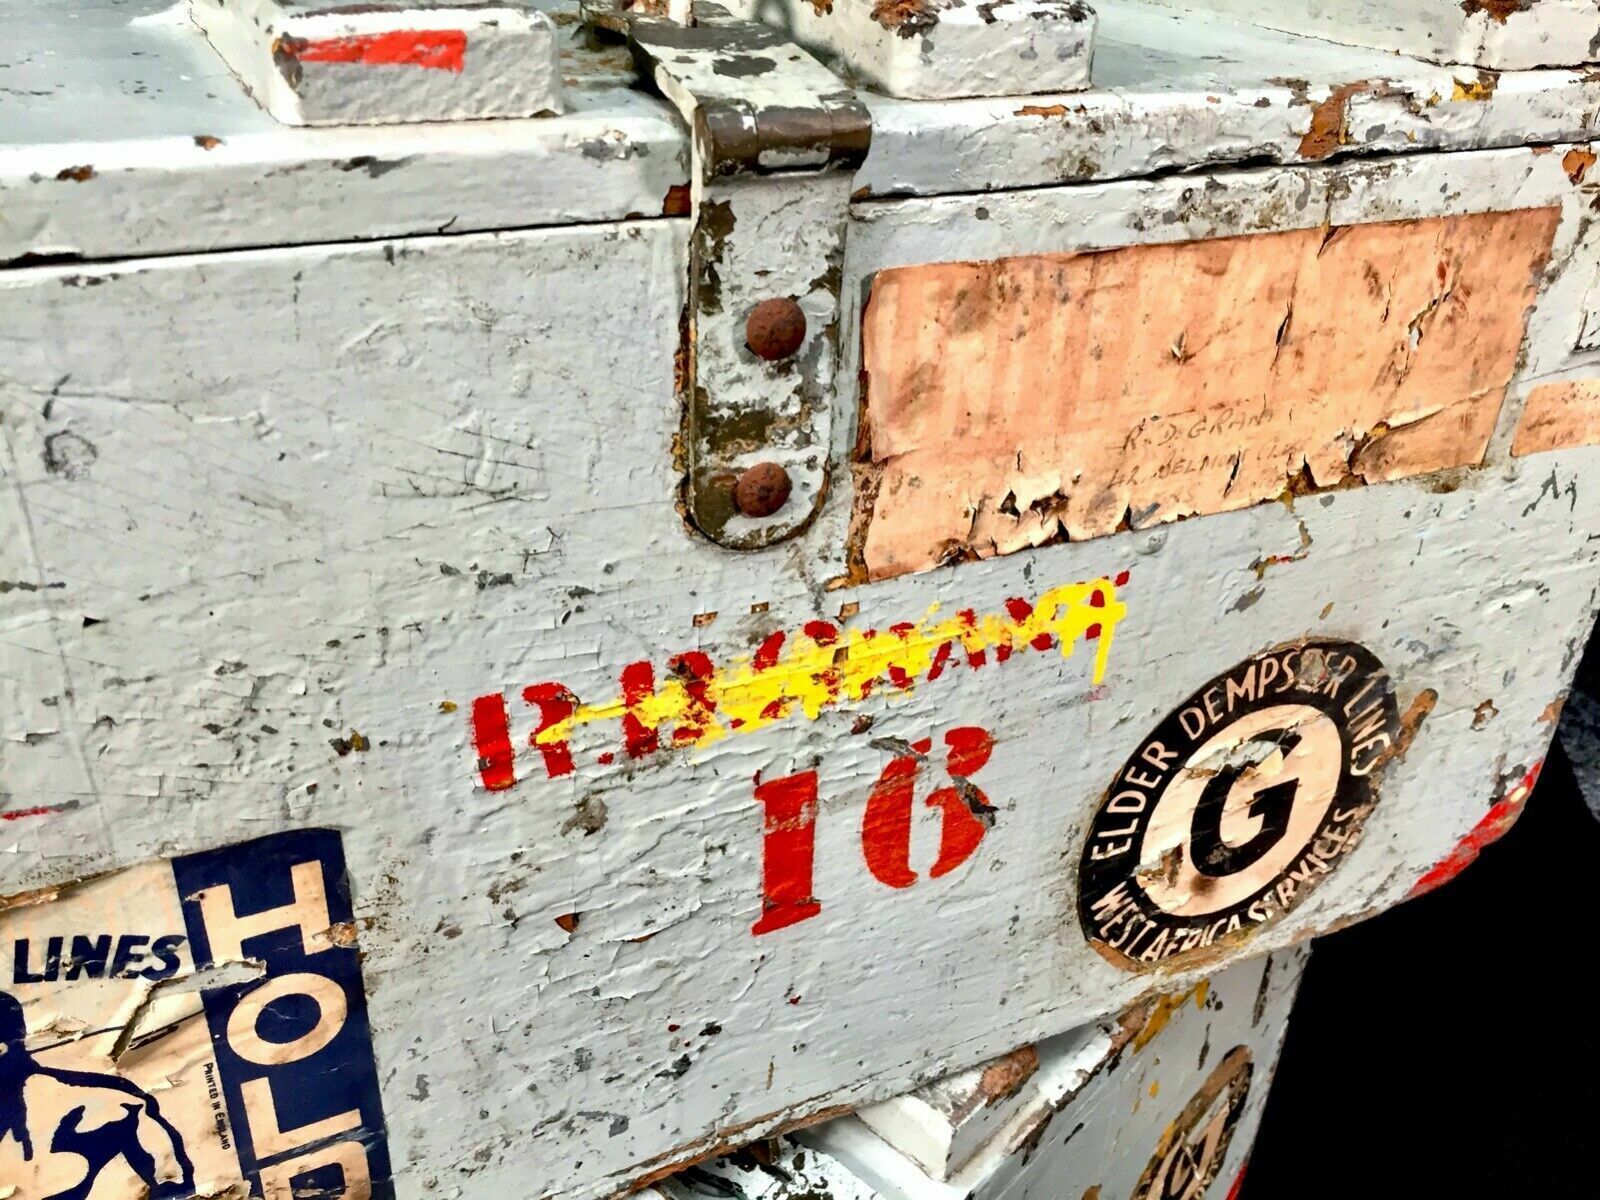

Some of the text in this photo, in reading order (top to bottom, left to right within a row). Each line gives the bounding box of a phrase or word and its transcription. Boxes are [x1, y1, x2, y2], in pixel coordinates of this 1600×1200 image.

[1092, 740, 1179, 861] ELDER
[1179, 650, 1357, 741] DEMPSER
[1190, 728, 1303, 878] G
[752, 727, 996, 935] 16
[13, 934, 190, 984] LINES
[1090, 881, 1158, 957] WEST
[203, 1062, 231, 1150] PRINTED IN ENGLAND
